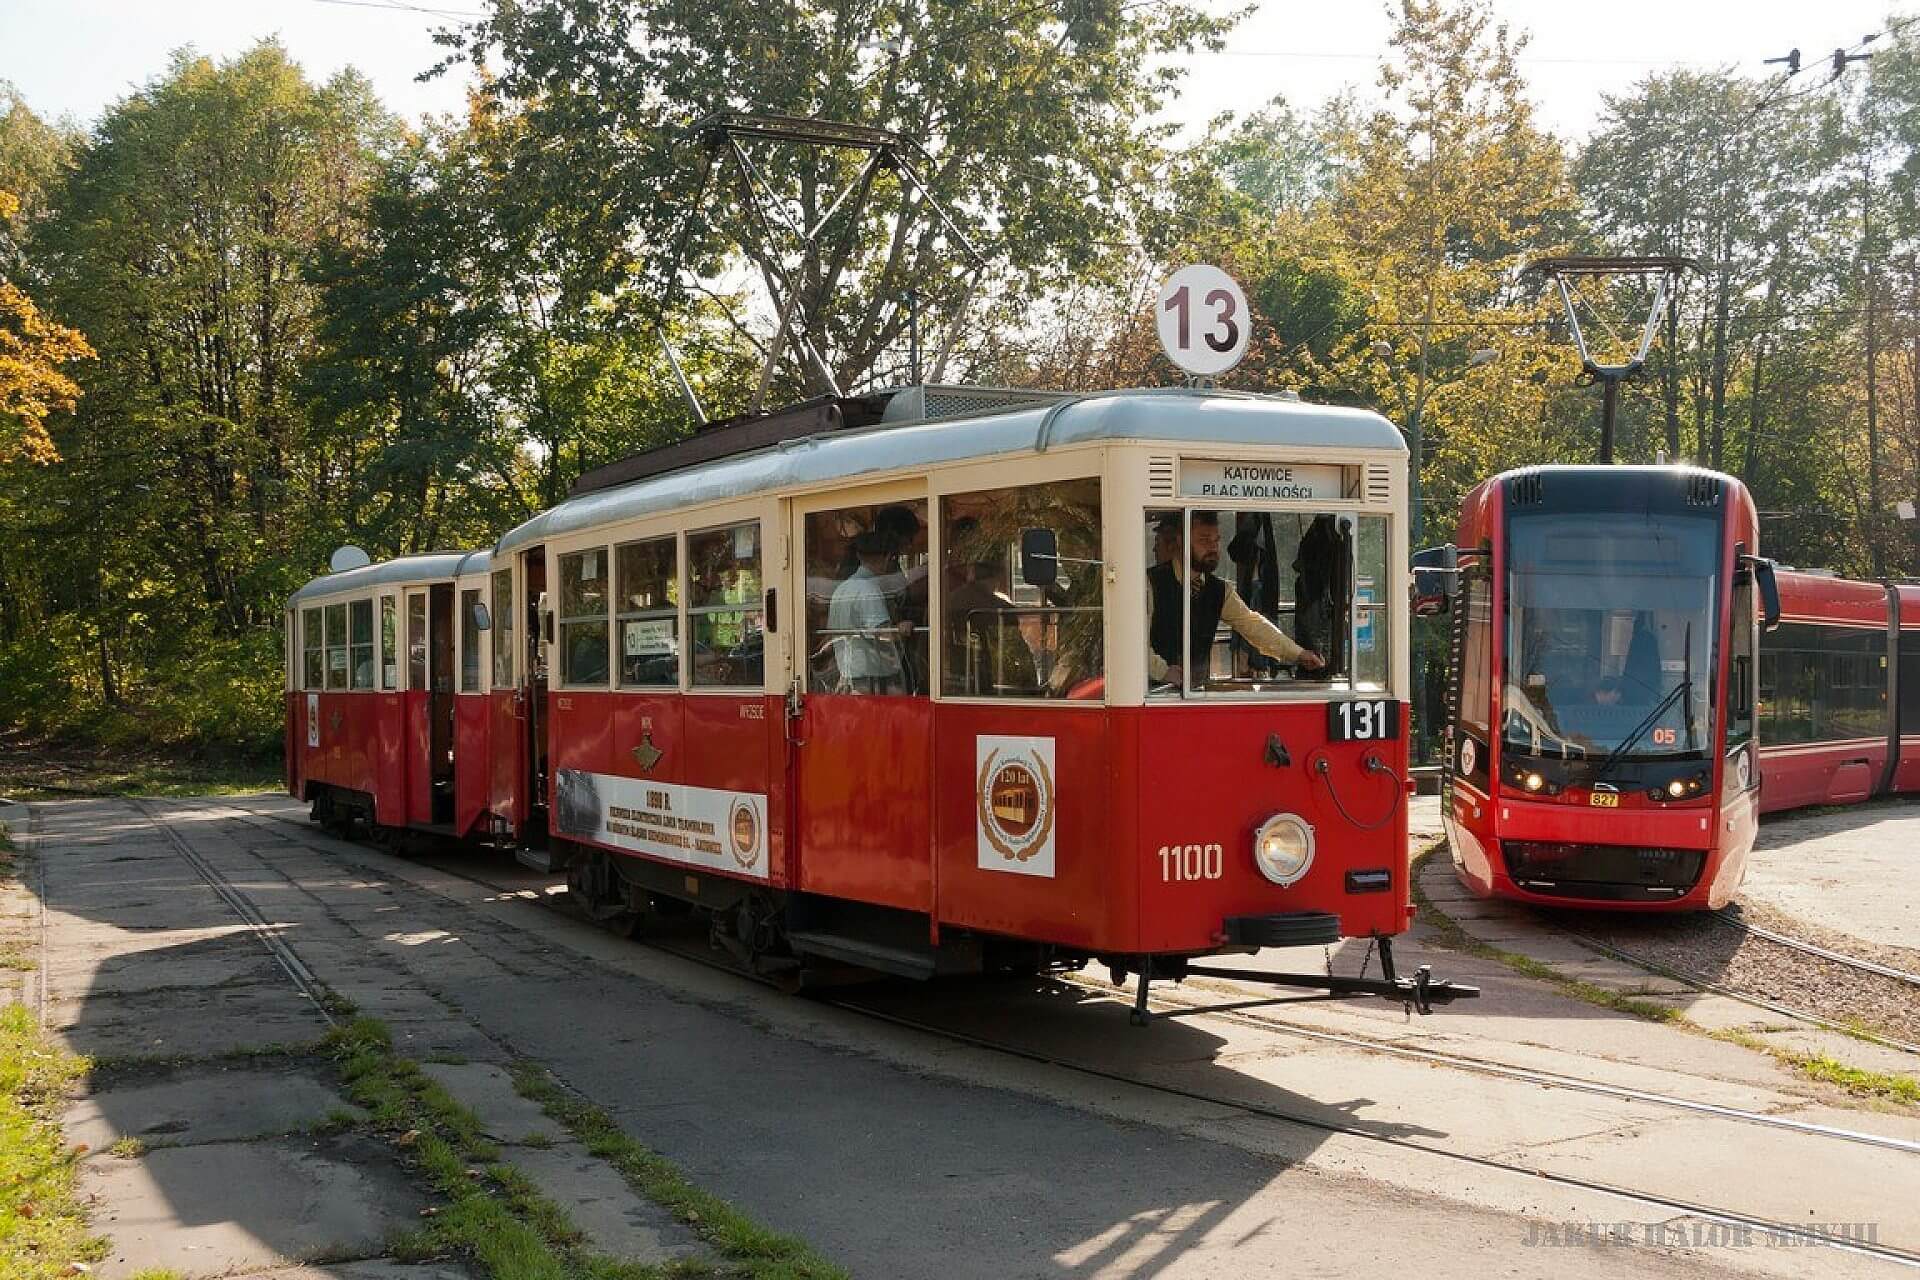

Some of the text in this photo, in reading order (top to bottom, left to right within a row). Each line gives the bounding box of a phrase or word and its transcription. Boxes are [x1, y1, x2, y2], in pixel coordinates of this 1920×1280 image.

[1165, 287, 1238, 352] 13
[1224, 466, 1293, 482] KATOWICE
[1202, 484, 1313, 499] PLAC WOLNOŚCI
[1339, 701, 1386, 740] 131
[1654, 728, 1676, 744] 05
[1159, 844, 1223, 882] 1100
